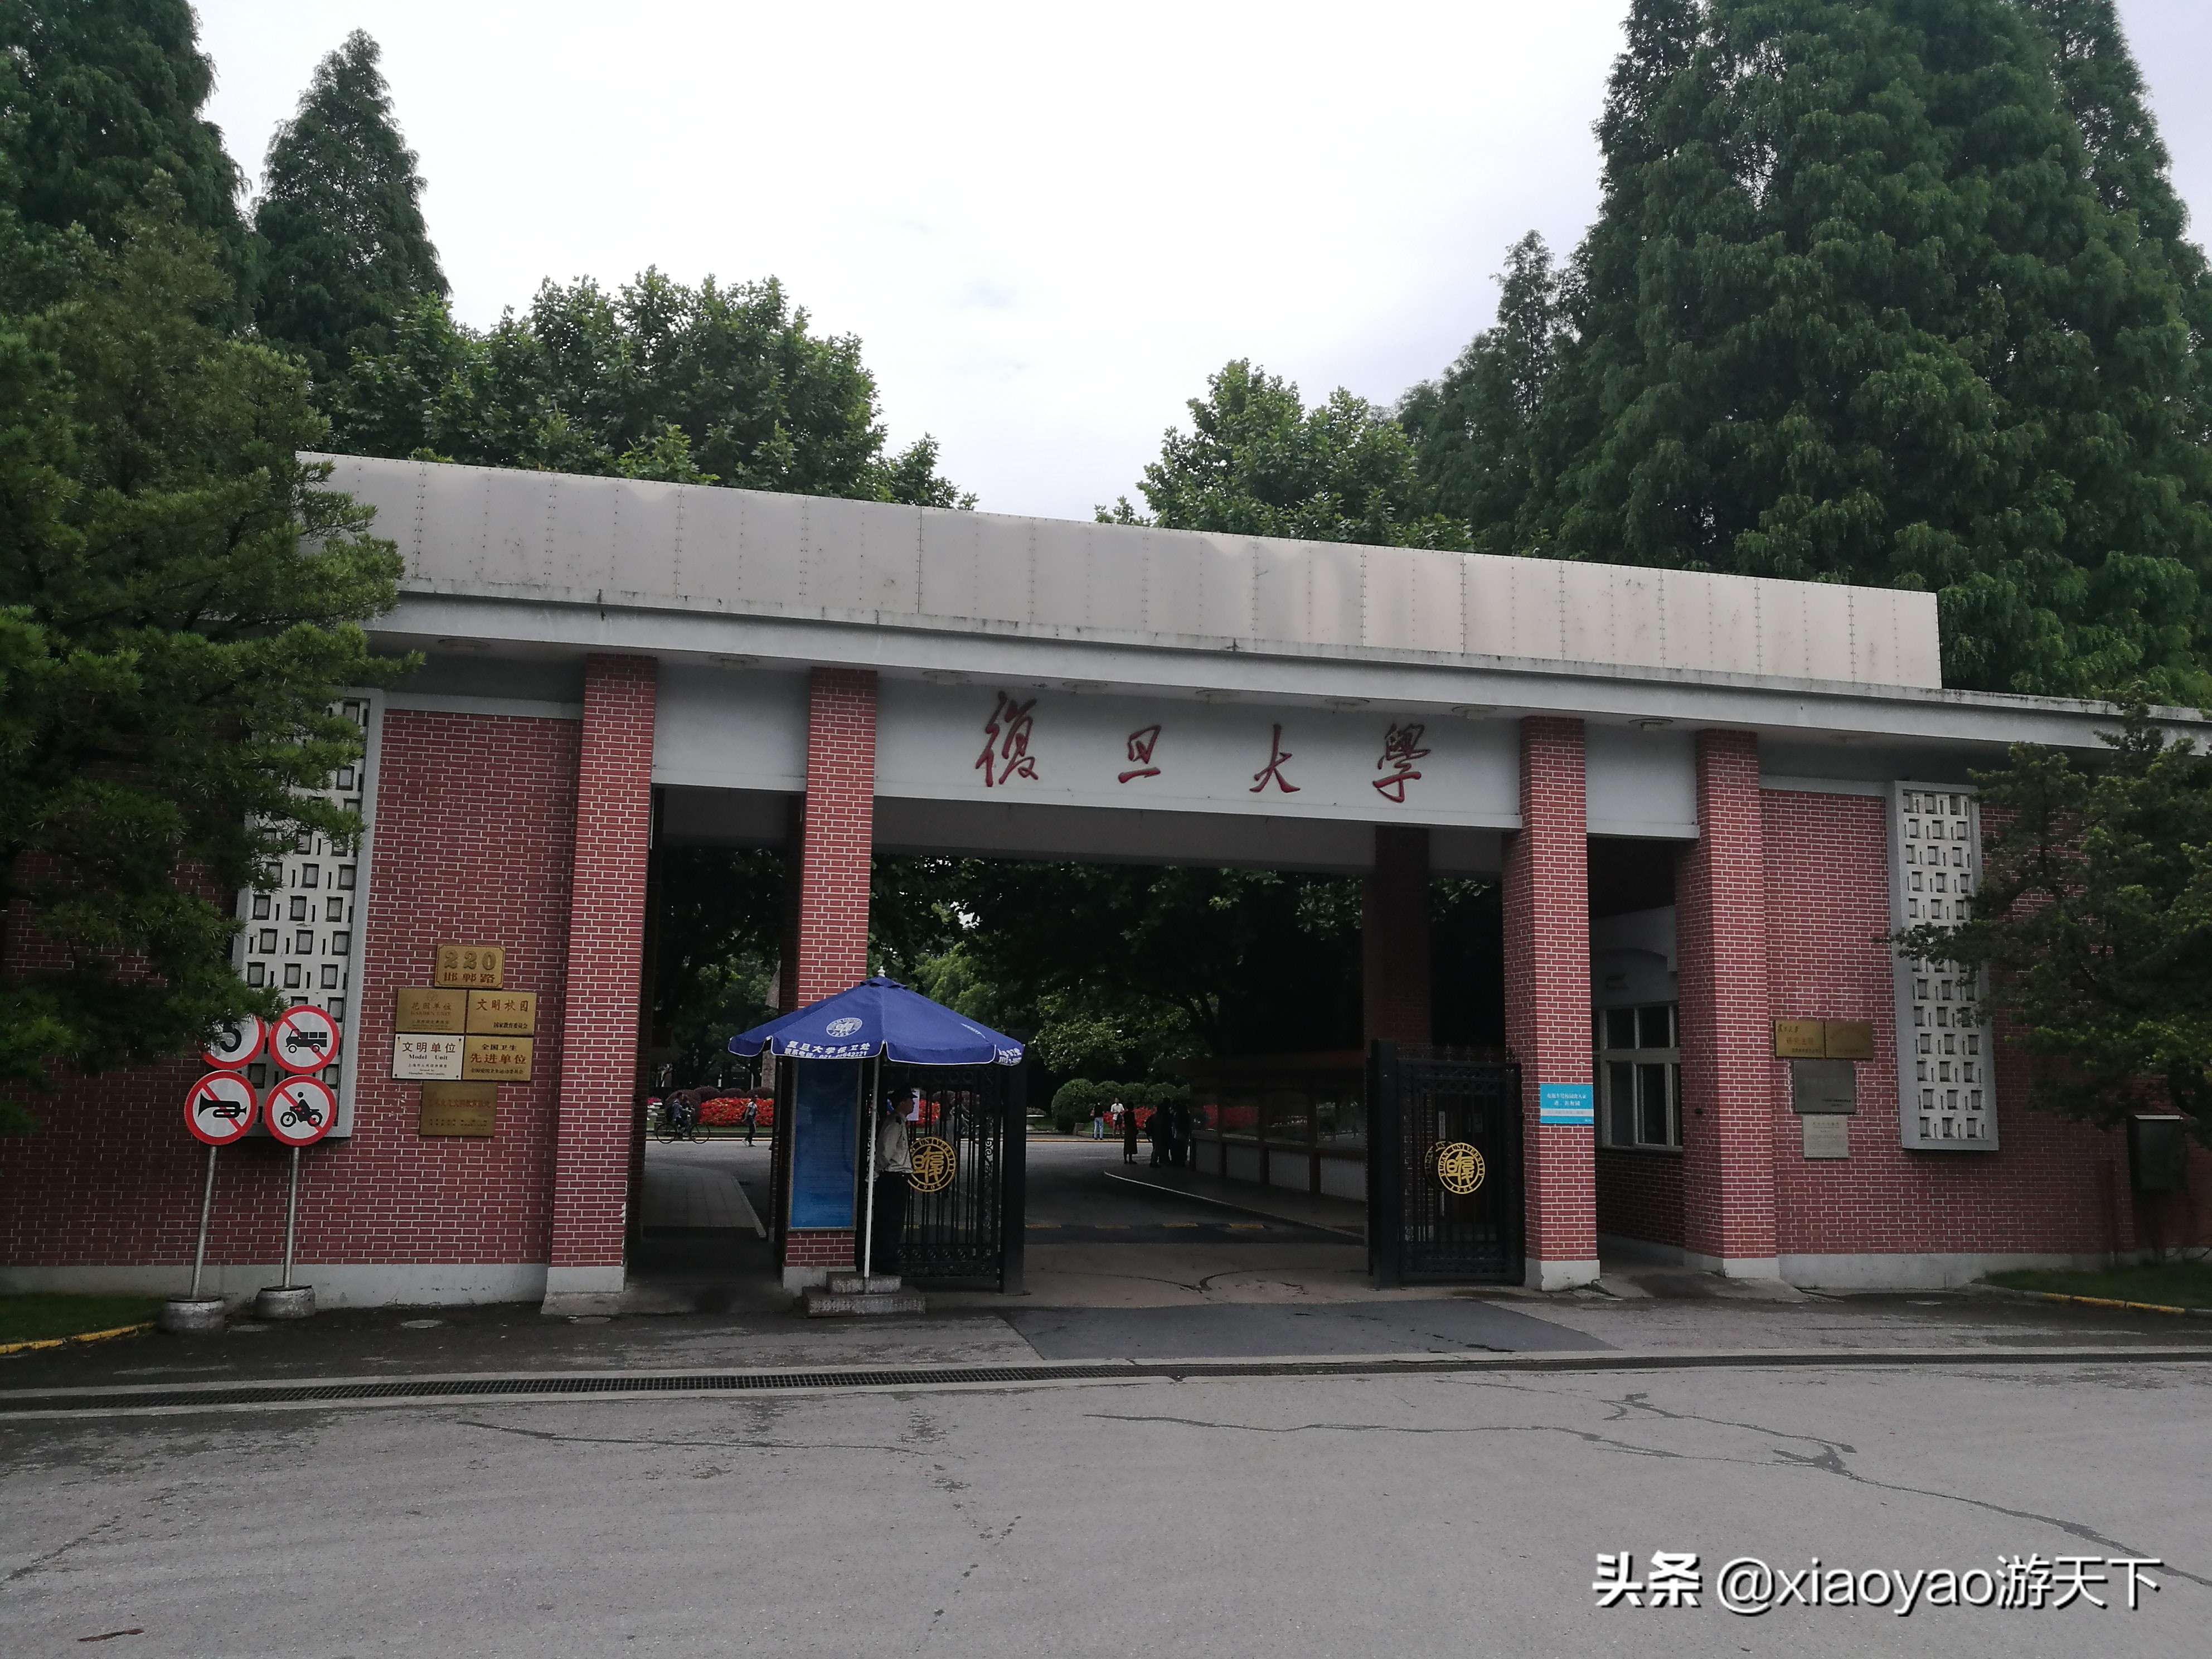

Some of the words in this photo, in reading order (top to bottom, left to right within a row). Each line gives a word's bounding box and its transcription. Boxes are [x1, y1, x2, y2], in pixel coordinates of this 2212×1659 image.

[444, 949, 497, 971] 220
[444, 972, 496, 983] 邯郸路
[476, 998, 528, 1011] 文明校园
[402, 1041, 456, 1053] 文明单位
[787, 1040, 871, 1054] 复旦大学保卫处
[470, 1053, 526, 1064] 先进单位
